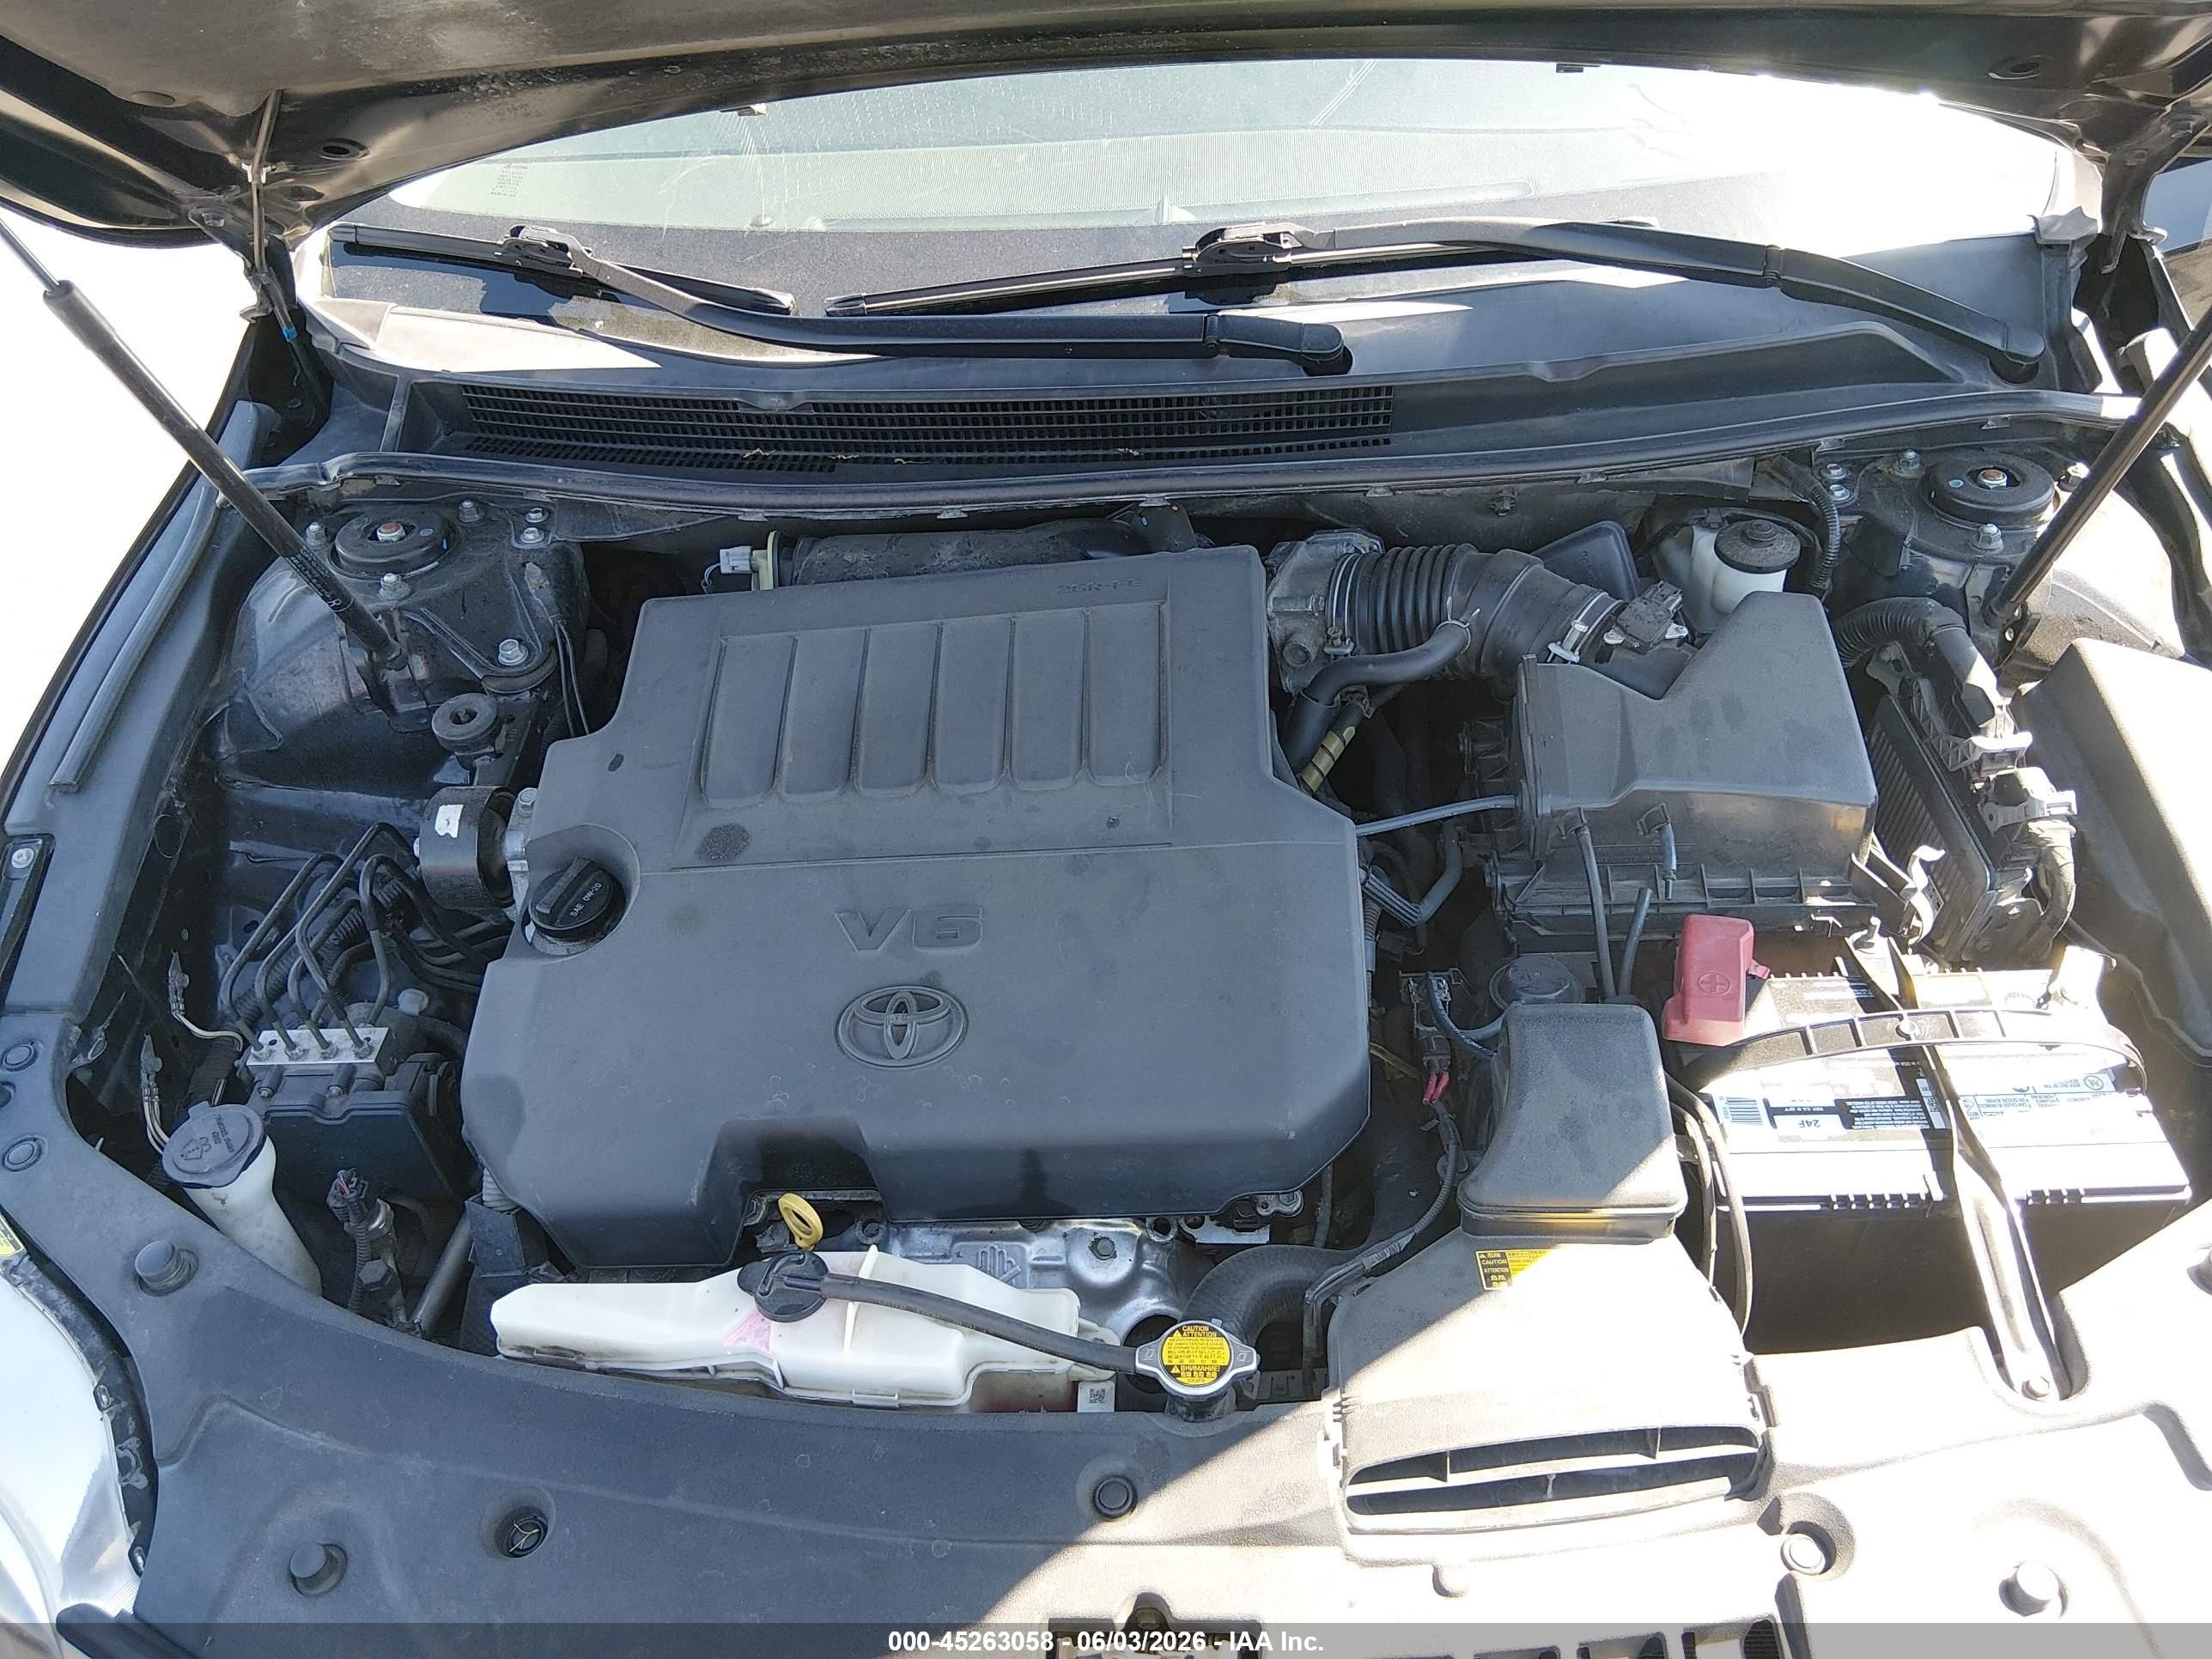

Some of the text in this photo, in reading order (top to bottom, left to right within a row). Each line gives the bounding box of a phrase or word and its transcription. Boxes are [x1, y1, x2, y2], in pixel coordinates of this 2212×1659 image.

[569, 882, 603, 917] SAE 0W-20
[832, 906, 983, 955] V6
[1797, 1119, 1821, 1128] 24F
